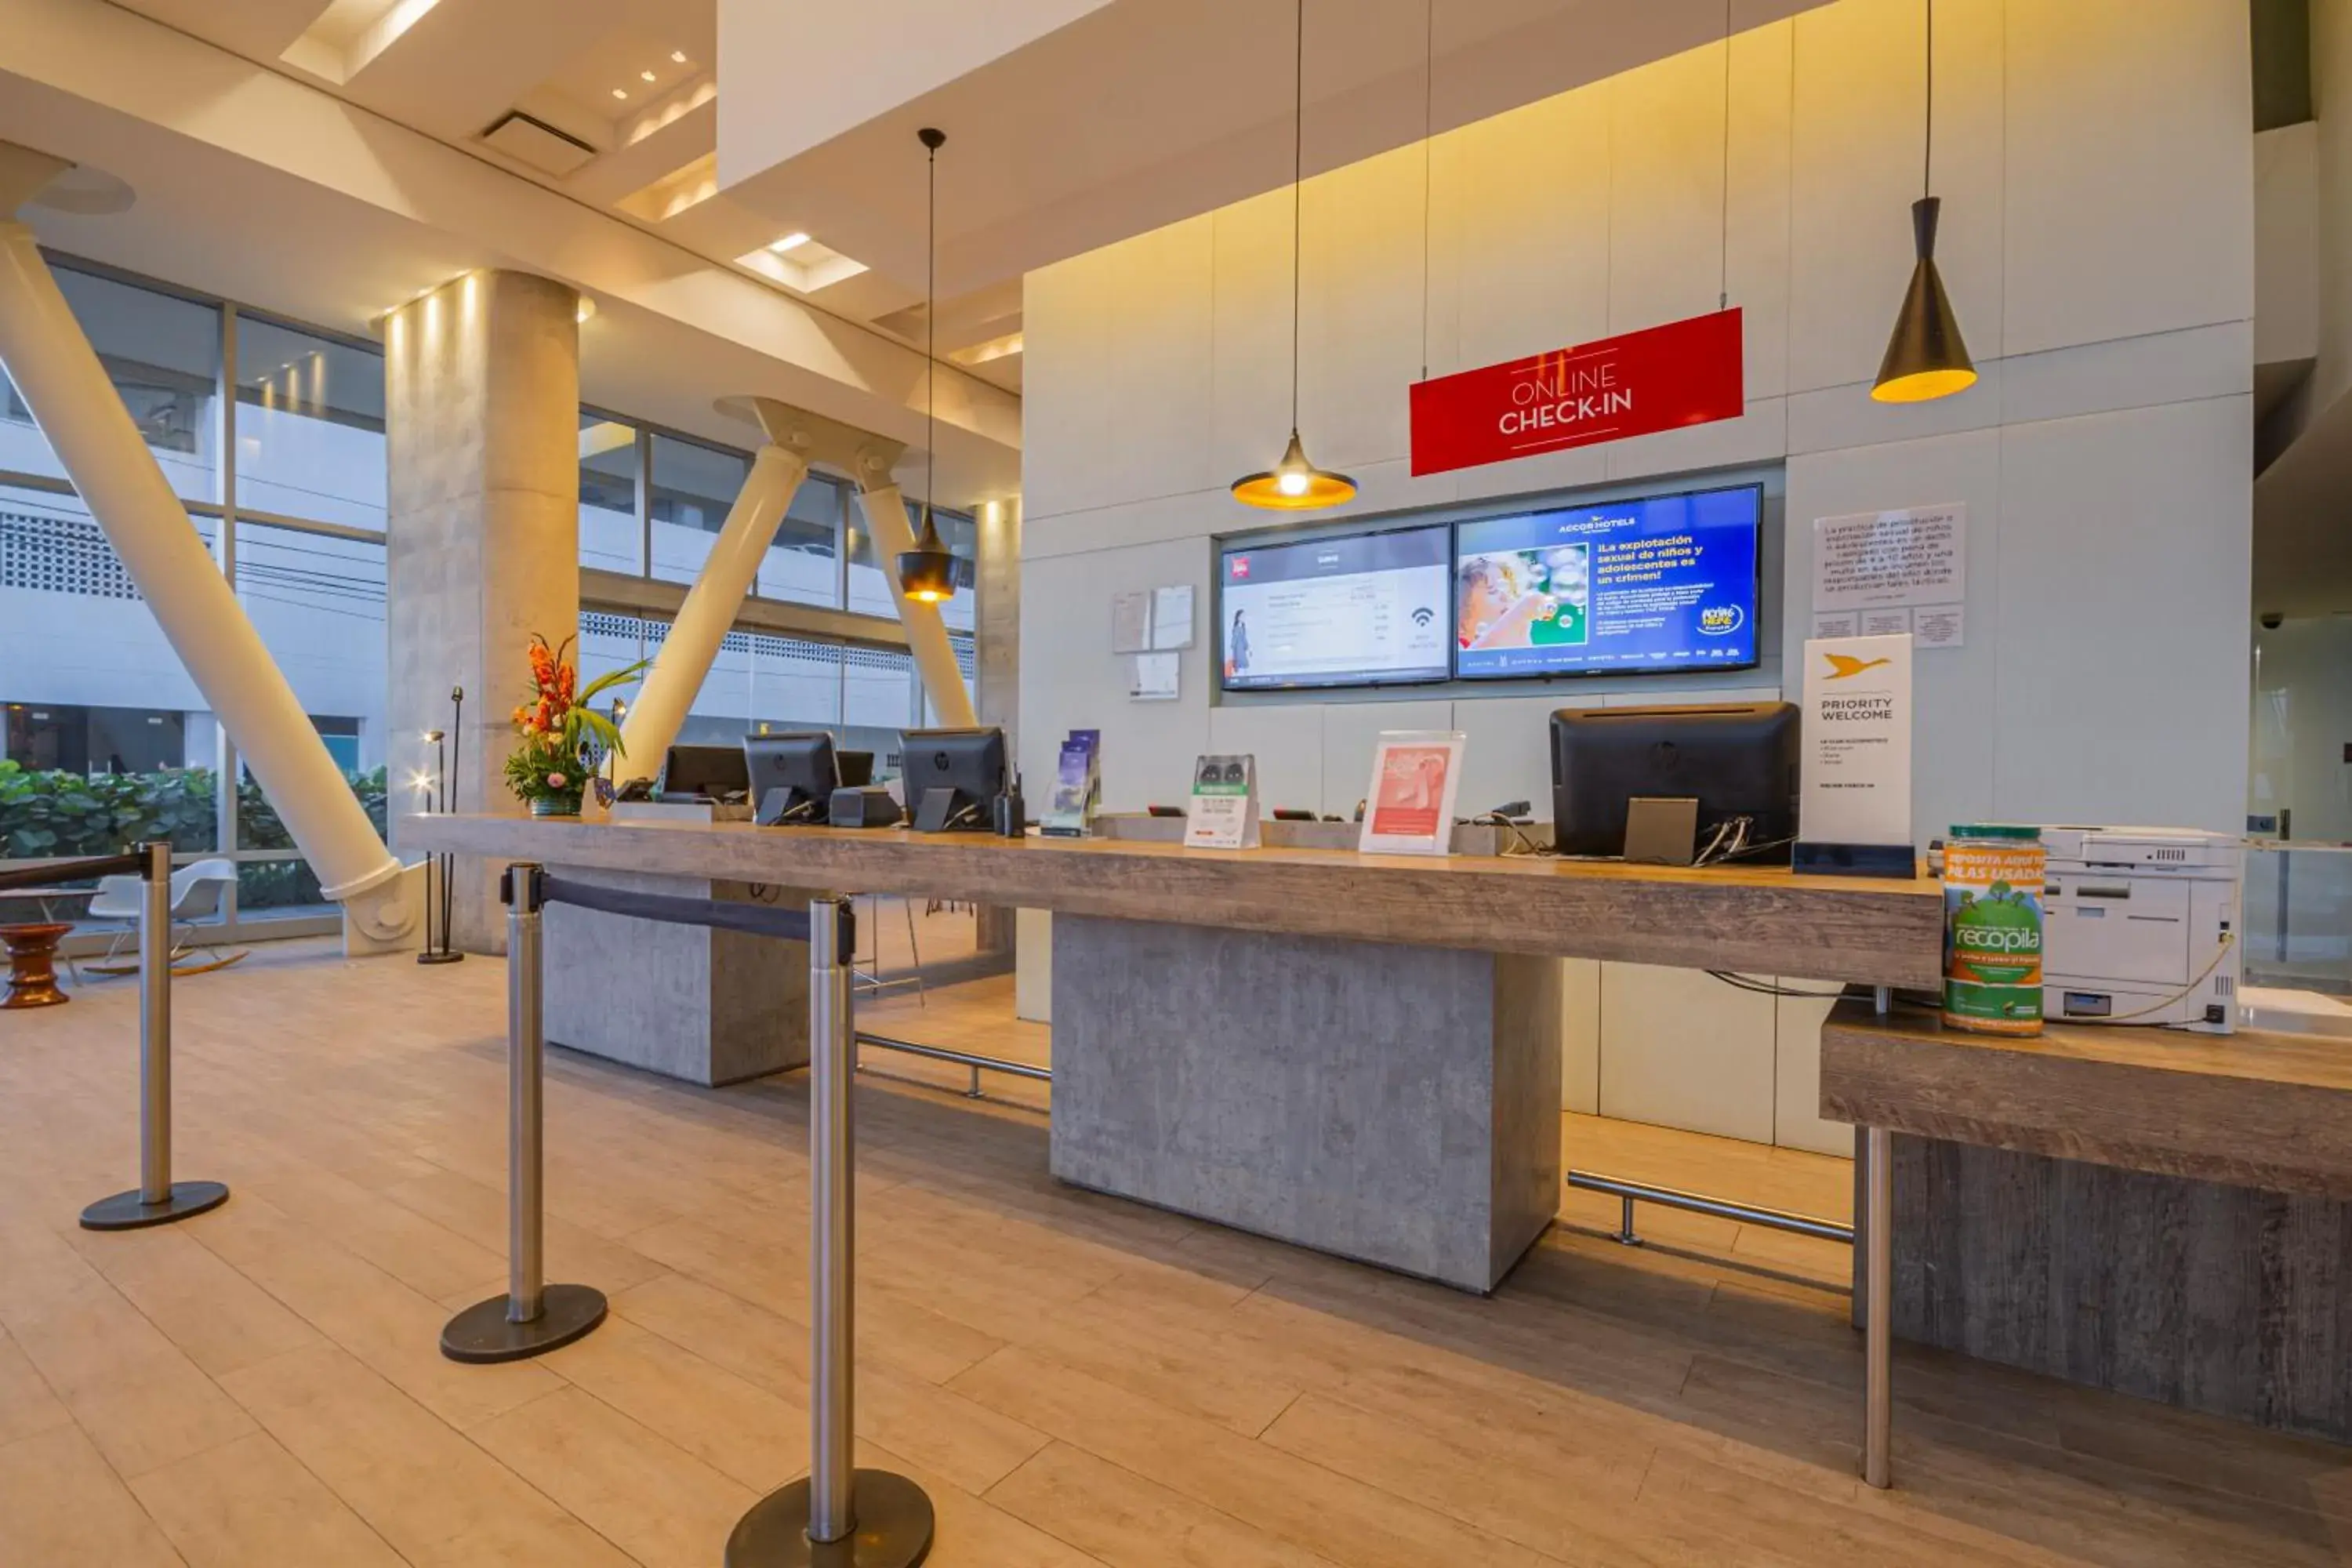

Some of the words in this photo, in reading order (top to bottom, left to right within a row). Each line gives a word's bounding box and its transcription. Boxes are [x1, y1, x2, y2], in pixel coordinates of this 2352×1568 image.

[1512, 364, 1616, 405] ONLINE
[1499, 388, 1632, 435] CHECK-IN
[1619, 535, 1693, 550] explotación
[1598, 552, 1635, 564] sexual
[1639, 550, 1654, 559] de
[1657, 547, 1692, 559] niños
[1694, 546, 1704, 556] y
[1598, 561, 1678, 575] adolescentes
[1680, 557, 1696, 567] es
[1598, 575, 1612, 584] un
[1616, 570, 1661, 583] crimen!
[1821, 699, 1892, 709] PRIORITY
[1821, 710, 1893, 720] WELCOME
[1956, 927, 2039, 953] recopila
